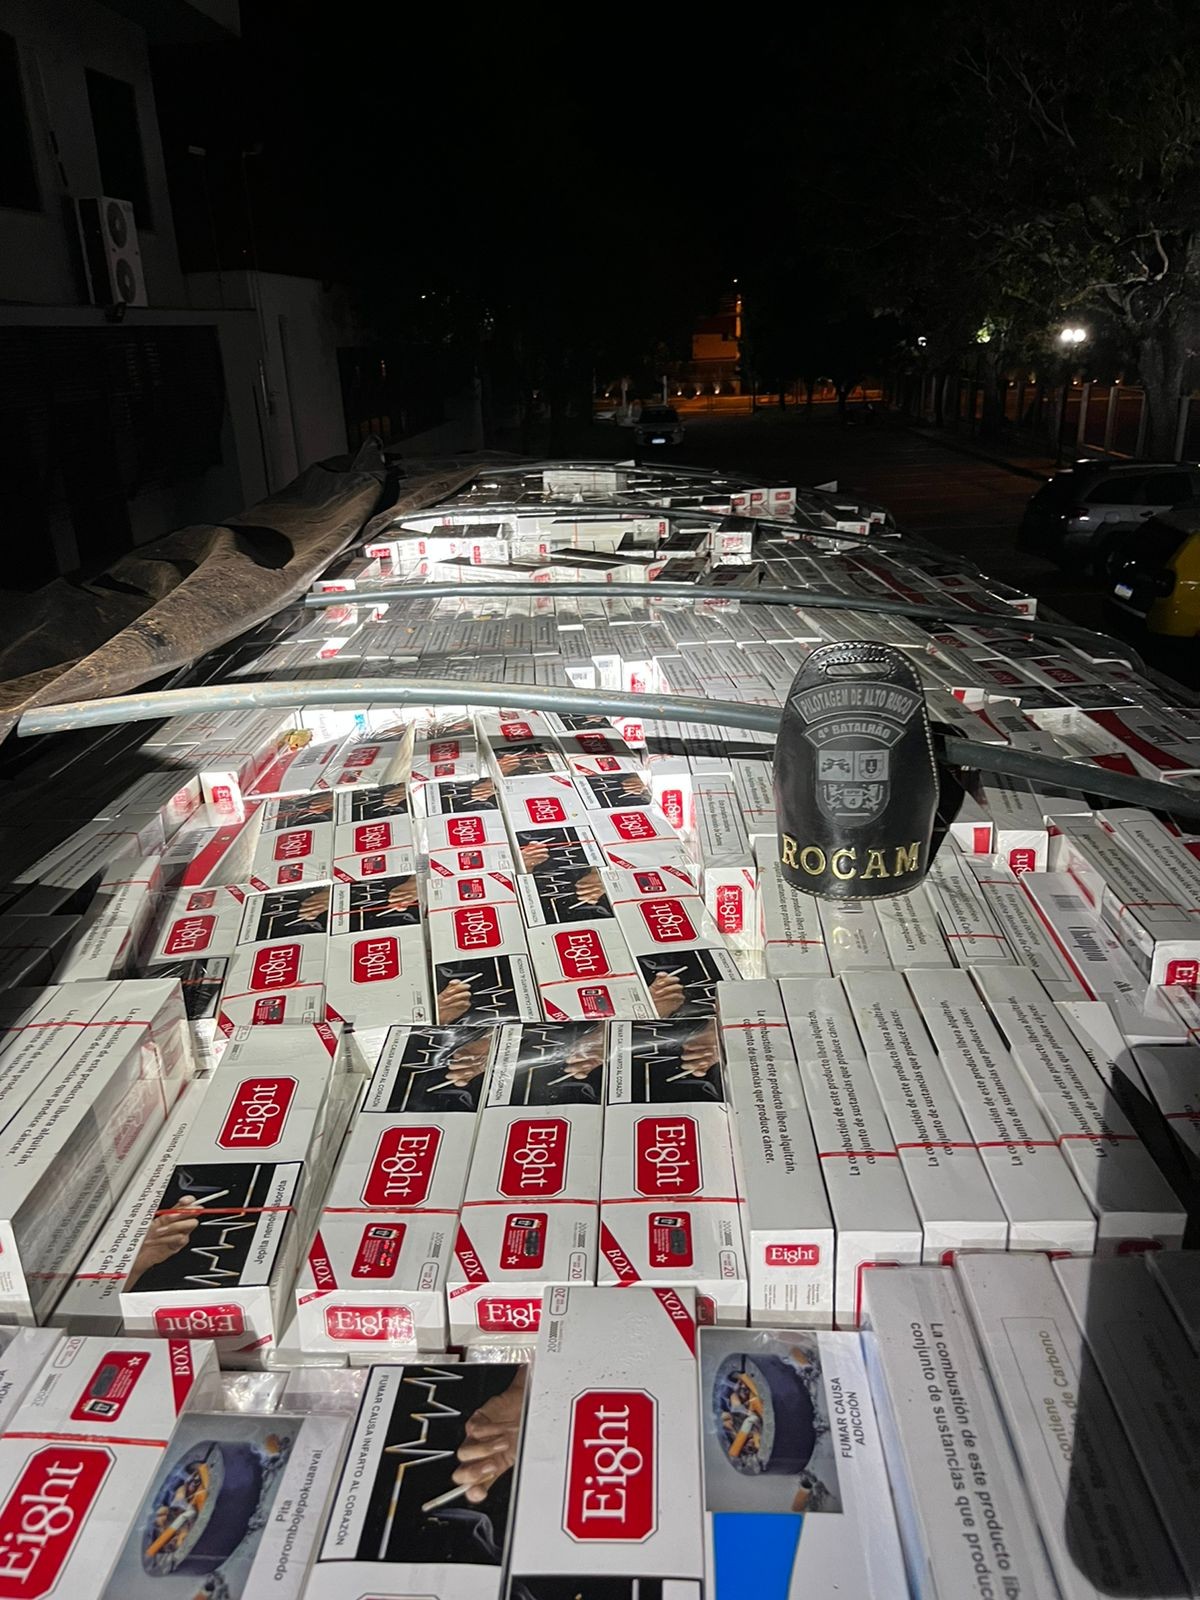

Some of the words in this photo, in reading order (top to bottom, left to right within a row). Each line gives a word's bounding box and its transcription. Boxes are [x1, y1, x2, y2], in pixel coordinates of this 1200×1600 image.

[800, 687, 848, 716] PILOTAGEM
[851, 688, 863, 706] DE
[863, 688, 884, 712] ALTO
[886, 692, 914, 716] RISCO
[832, 723, 891, 739] BATALHÃO
[532, 799, 559, 823] Eight
[360, 825, 386, 849] Eight
[452, 818, 478, 844] Eight
[618, 813, 648, 838] Eight
[781, 833, 922, 880] ROCAM
[1010, 853, 1030, 874] ght
[650, 903, 684, 939] Eight
[719, 889, 738, 929] Eight
[171, 918, 207, 951] Eight
[461, 910, 494, 945] Eight
[359, 941, 393, 977] Eight
[564, 933, 601, 972] Eight
[259, 948, 293, 985] Eight
[128, 1006, 140, 1015] La
[756, 1008, 765, 1017] La
[807, 1007, 822, 1040] alquitrán,
[872, 1000, 888, 1031] alquitrán,
[889, 1008, 904, 1030] cáncer.
[940, 999, 959, 1029] alquitrán,
[958, 1007, 974, 1028] cáncer.
[317, 1023, 334, 1040] BOX
[825, 1015, 838, 1038] cáncer.
[882, 1030, 895, 1050] libera
[953, 1029, 967, 1049] libera
[89, 1040, 99, 1050] de
[97, 1048, 108, 1058] de
[747, 1046, 757, 1055] de
[815, 1039, 827, 1059] libera
[831, 1038, 848, 1065] produce
[898, 1029, 917, 1056] produce
[969, 1028, 990, 1055] produce
[61, 1049, 92, 1083] sustancias
[86, 1057, 100, 1073] este
[748, 1054, 763, 1089] sustancias
[764, 1053, 775, 1063] de
[766, 1062, 777, 1078] este
[889, 1050, 910, 1082] producto
[908, 1056, 921, 1070] que
[962, 1048, 985, 1079] producto
[981, 1054, 995, 1069] que
[821, 1059, 839, 1090] producto
[839, 1065, 852, 1079] que
[50, 1083, 66, 1098] que
[61, 1072, 90, 1104] producto
[752, 1088, 764, 1104] que
[766, 1077, 783, 1110] producto
[829, 1089, 841, 1107] este
[842, 1079, 861, 1117] sustancias
[901, 1081, 913, 1098] este
[913, 1069, 935, 1108] sustancias
[976, 1079, 990, 1096] este
[988, 1068, 1011, 1106] sustancias
[28, 1097, 55, 1128] produce
[231, 1083, 279, 1141] Eight
[832, 1106, 843, 1117] de
[905, 1098, 917, 1109] de
[926, 1108, 938, 1119] de
[983, 1095, 995, 1107] de
[1005, 1106, 1017, 1117] de
[45, 1104, 69, 1127] libera
[753, 1103, 770, 1135] produce
[775, 1109, 787, 1133] libera
[852, 1117, 864, 1128] de
[5, 1127, 32, 1157] cáncer.
[13, 1126, 49, 1168] alquitrán,
[165, 1121, 187, 1153] conjunto
[762, 1134, 774, 1165] cáncer.
[161, 1152, 171, 1163] de
[381, 1134, 432, 1198] Eight
[513, 1125, 559, 1188] Eight
[644, 1124, 690, 1187] Eight
[778, 1133, 795, 1175] alquitrán,
[927, 1156, 939, 1167] La
[1011, 1154, 1022, 1166] La
[138, 1162, 165, 1202] sustancias
[849, 1165, 860, 1176] La
[128, 1201, 142, 1218] que
[109, 1218, 133, 1254] produce
[125, 1226, 147, 1252] libera
[459, 1250, 483, 1278] BOX
[608, 1249, 633, 1276] BOX
[770, 1247, 815, 1264] Eight
[89, 1253, 113, 1288] cáncr.
[98, 1252, 131, 1300] alqurán,
[313, 1257, 333, 1285] BOX
[421, 1278, 433, 1290] 20
[571, 1268, 582, 1279] 20
[724, 1267, 735, 1277] 20
[554, 1287, 566, 1298] 20
[660, 1291, 687, 1321] BOX
[164, 1306, 236, 1332] Eight
[486, 1301, 542, 1329] Eigh
[930, 1321, 943, 1338] La
[72, 1339, 81, 1350] 20
[910, 1321, 935, 1381] conjunto
[1038, 1329, 1068, 1387] Carbono
[172, 1345, 190, 1376] BOX
[374, 1373, 388, 1404] FUMAR
[830, 1376, 845, 1415] CAUSA
[927, 1383, 942, 1402] de
[935, 1340, 969, 1425] combustión
[1060, 1390, 1078, 1409] de
[365, 1404, 380, 1436] CAUSA
[845, 1390, 864, 1446] ADICCIÓN
[836, 1416, 852, 1459] FUMAR
[933, 1405, 965, 1491] sustancias
[961, 1428, 976, 1448] de
[353, 1437, 371, 1478] INFARTO
[581, 1404, 643, 1523] Eight
[968, 1451, 986, 1486] este
[349, 1479, 359, 1493] AL
[0, 1461, 84, 1585] Eight
[275, 1499, 291, 1522] Pita
[335, 1494, 356, 1546] CORAZÓN
[954, 1495, 975, 1528] que
[974, 1490, 1010, 1570] producto
